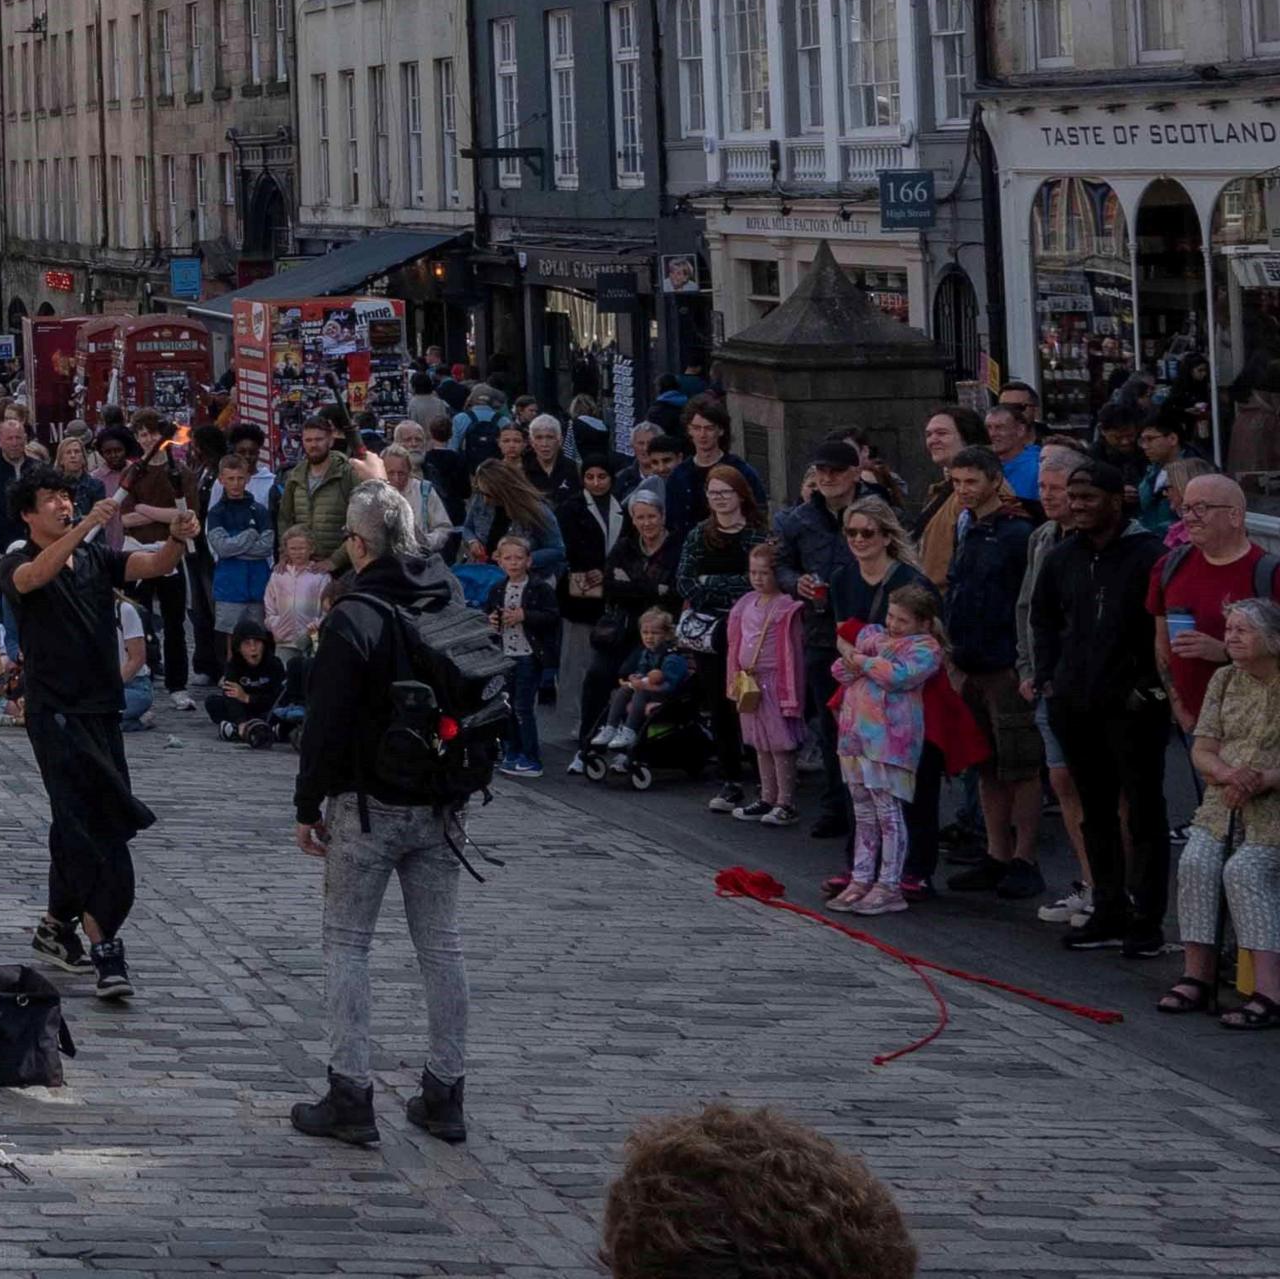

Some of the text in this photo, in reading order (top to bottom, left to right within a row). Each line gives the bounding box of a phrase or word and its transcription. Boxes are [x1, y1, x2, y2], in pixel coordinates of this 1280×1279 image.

[1041, 121, 1276, 146] TASTE OF SCOTLAND
[887, 181, 927, 203] 166
[886, 209, 931, 219] High Street
[746, 217, 868, 234] ROYAL MILE FACTORY OUTLET
[538, 260, 569, 277] ROYAL
[137, 341, 199, 352] TELEPHONE
